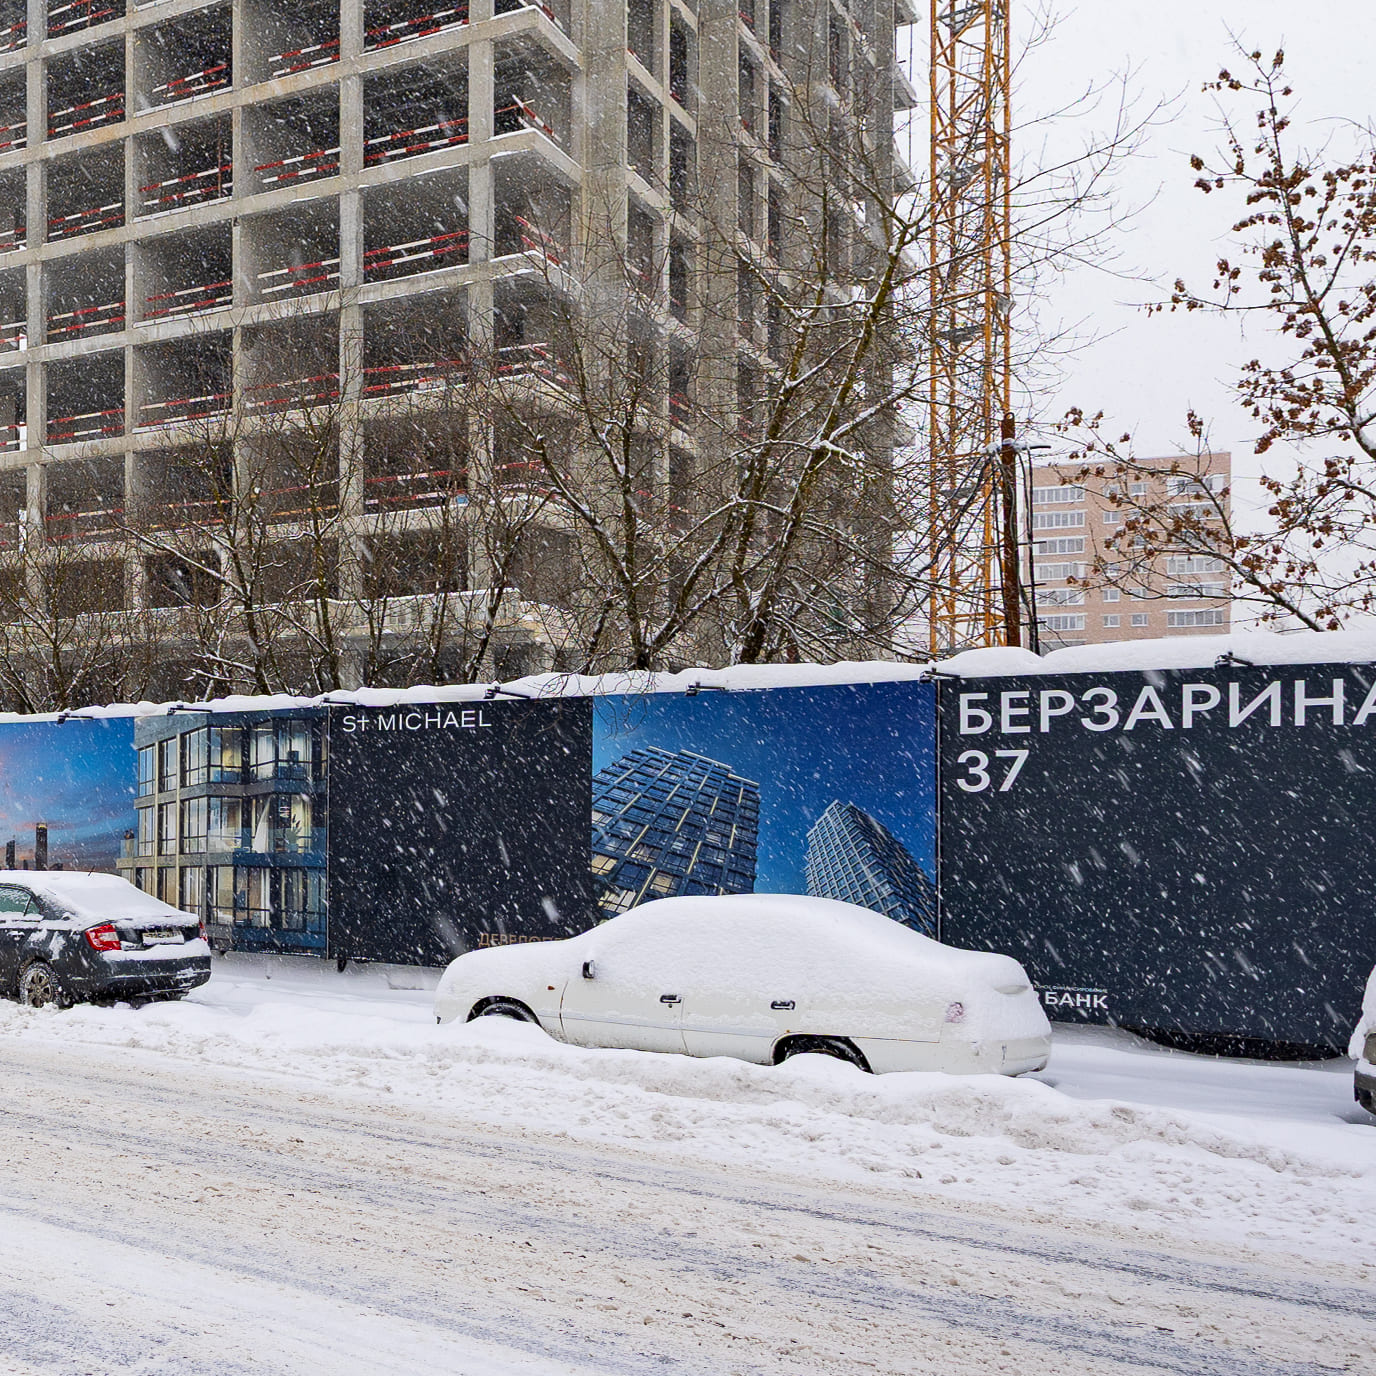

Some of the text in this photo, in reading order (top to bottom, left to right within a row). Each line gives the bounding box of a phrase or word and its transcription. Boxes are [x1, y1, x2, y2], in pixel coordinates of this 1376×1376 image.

[342, 710, 492, 732] St MICHAEL
[956, 749, 1030, 793] 37
[1045, 992, 1108, 1009] БАНК
